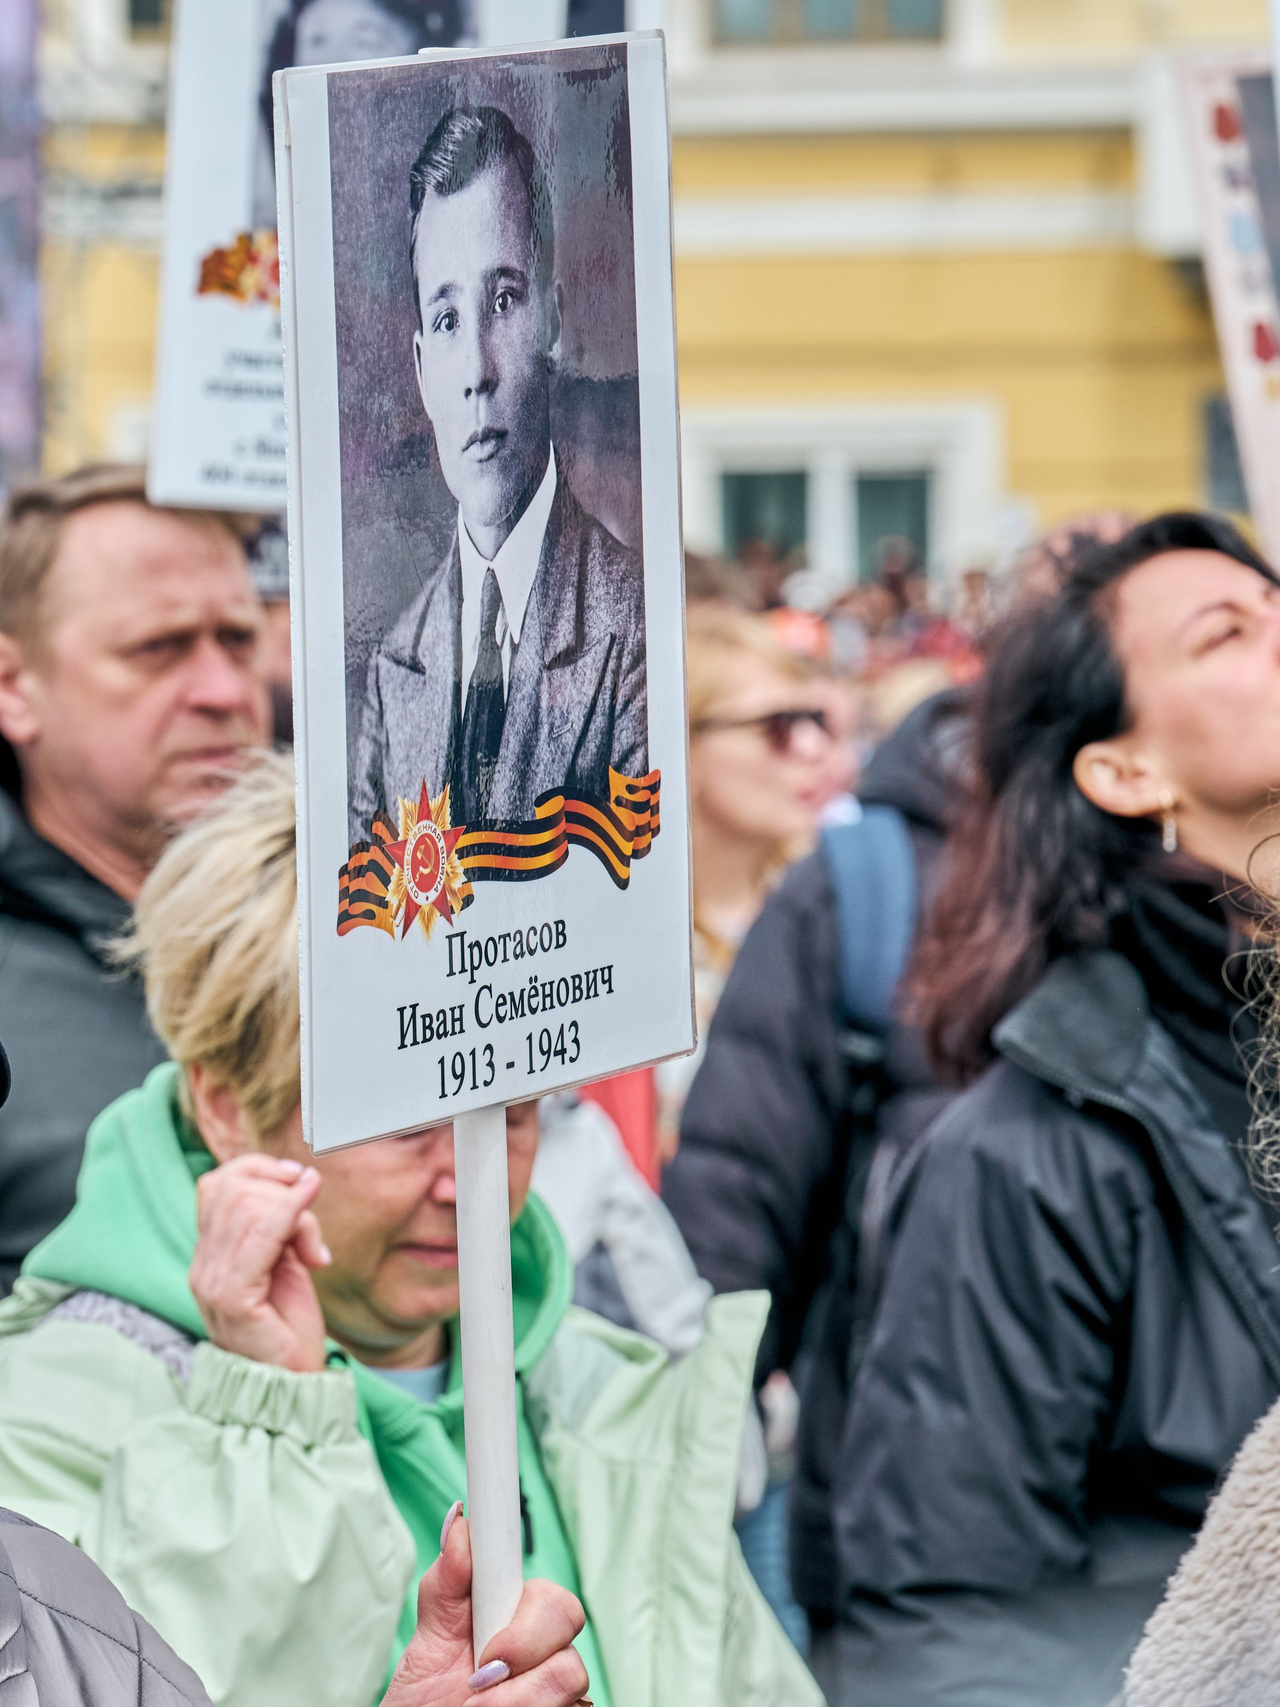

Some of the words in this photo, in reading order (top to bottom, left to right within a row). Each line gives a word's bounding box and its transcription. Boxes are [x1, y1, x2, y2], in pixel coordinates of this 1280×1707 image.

[445, 919, 567, 984] Протасов
[397, 1003, 465, 1050] Иван
[474, 964, 615, 1029] Семёнович
[438, 1044, 496, 1099] 1913
[526, 1020, 581, 1075] 1943
